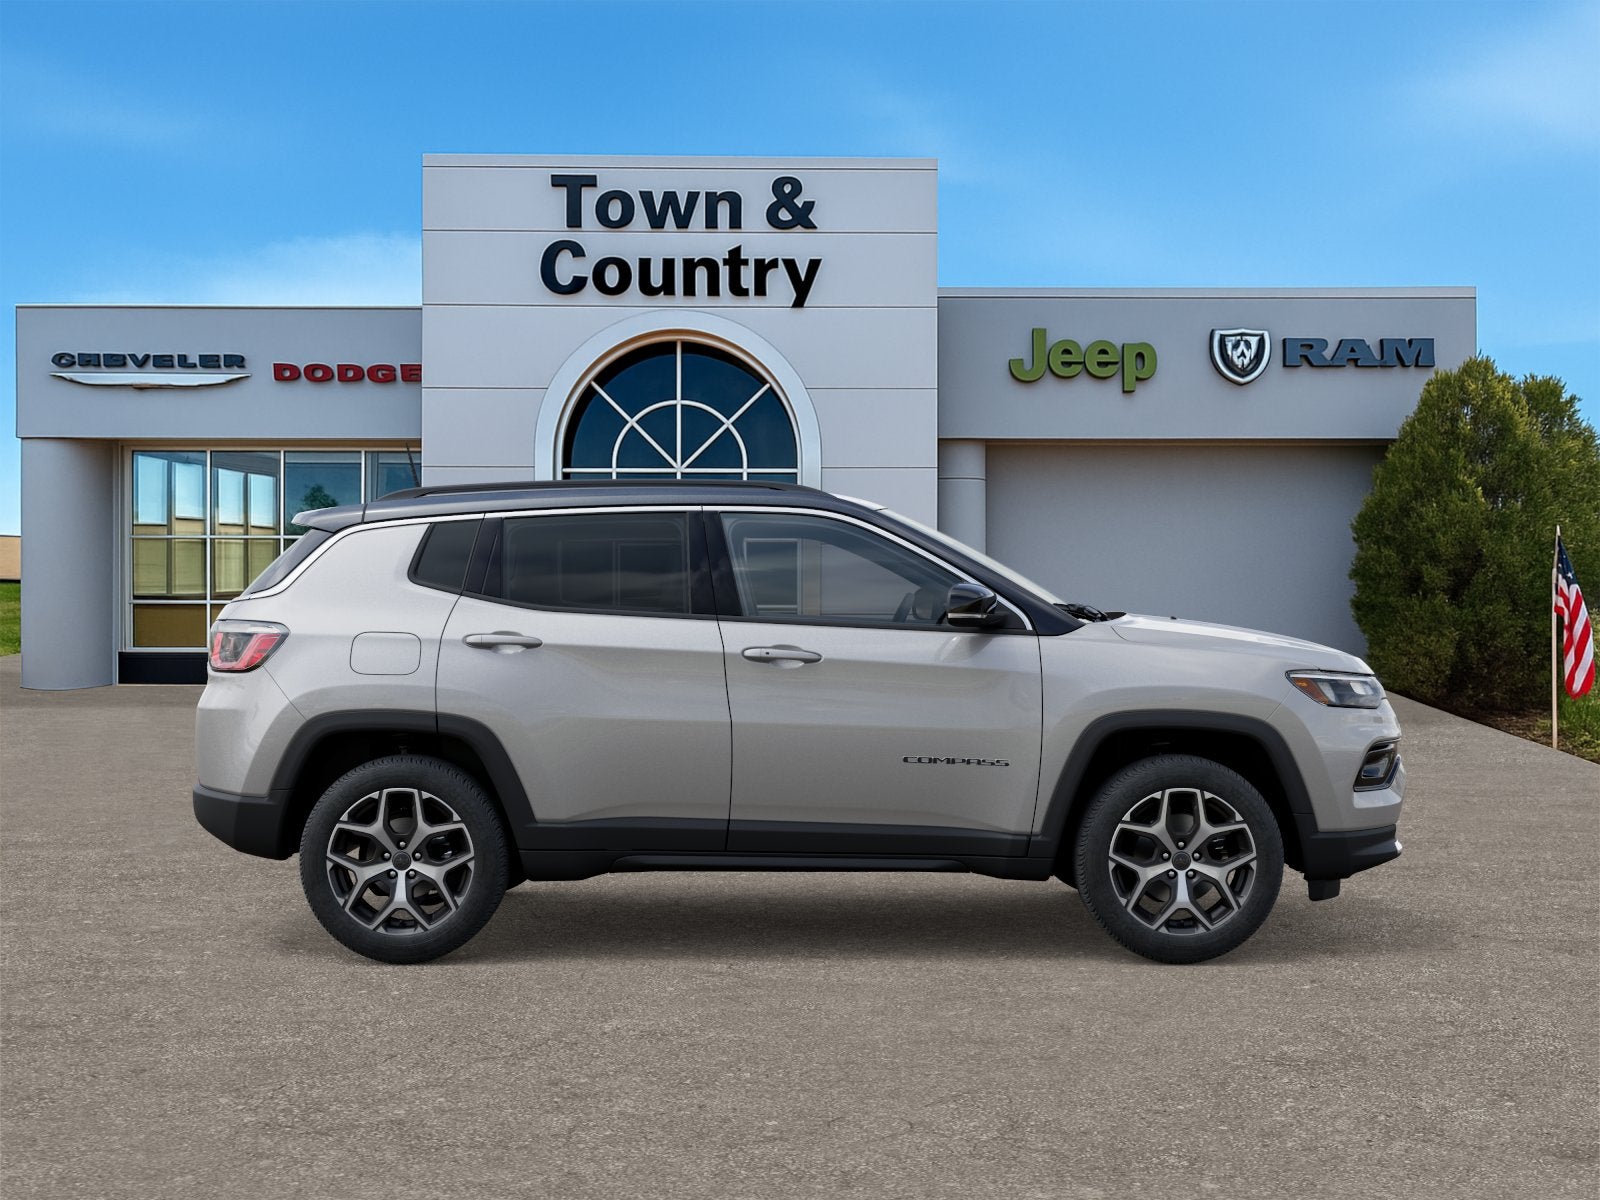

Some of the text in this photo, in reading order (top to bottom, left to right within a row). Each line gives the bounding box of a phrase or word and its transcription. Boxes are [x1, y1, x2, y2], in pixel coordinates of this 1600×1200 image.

[550, 174, 818, 230] Town &
[540, 239, 823, 308] Country
[272, 362, 421, 384] DODGE
[1009, 328, 1157, 393] Jeep
[1282, 337, 1435, 368] RAM
[902, 756, 1010, 767] COMPASS
